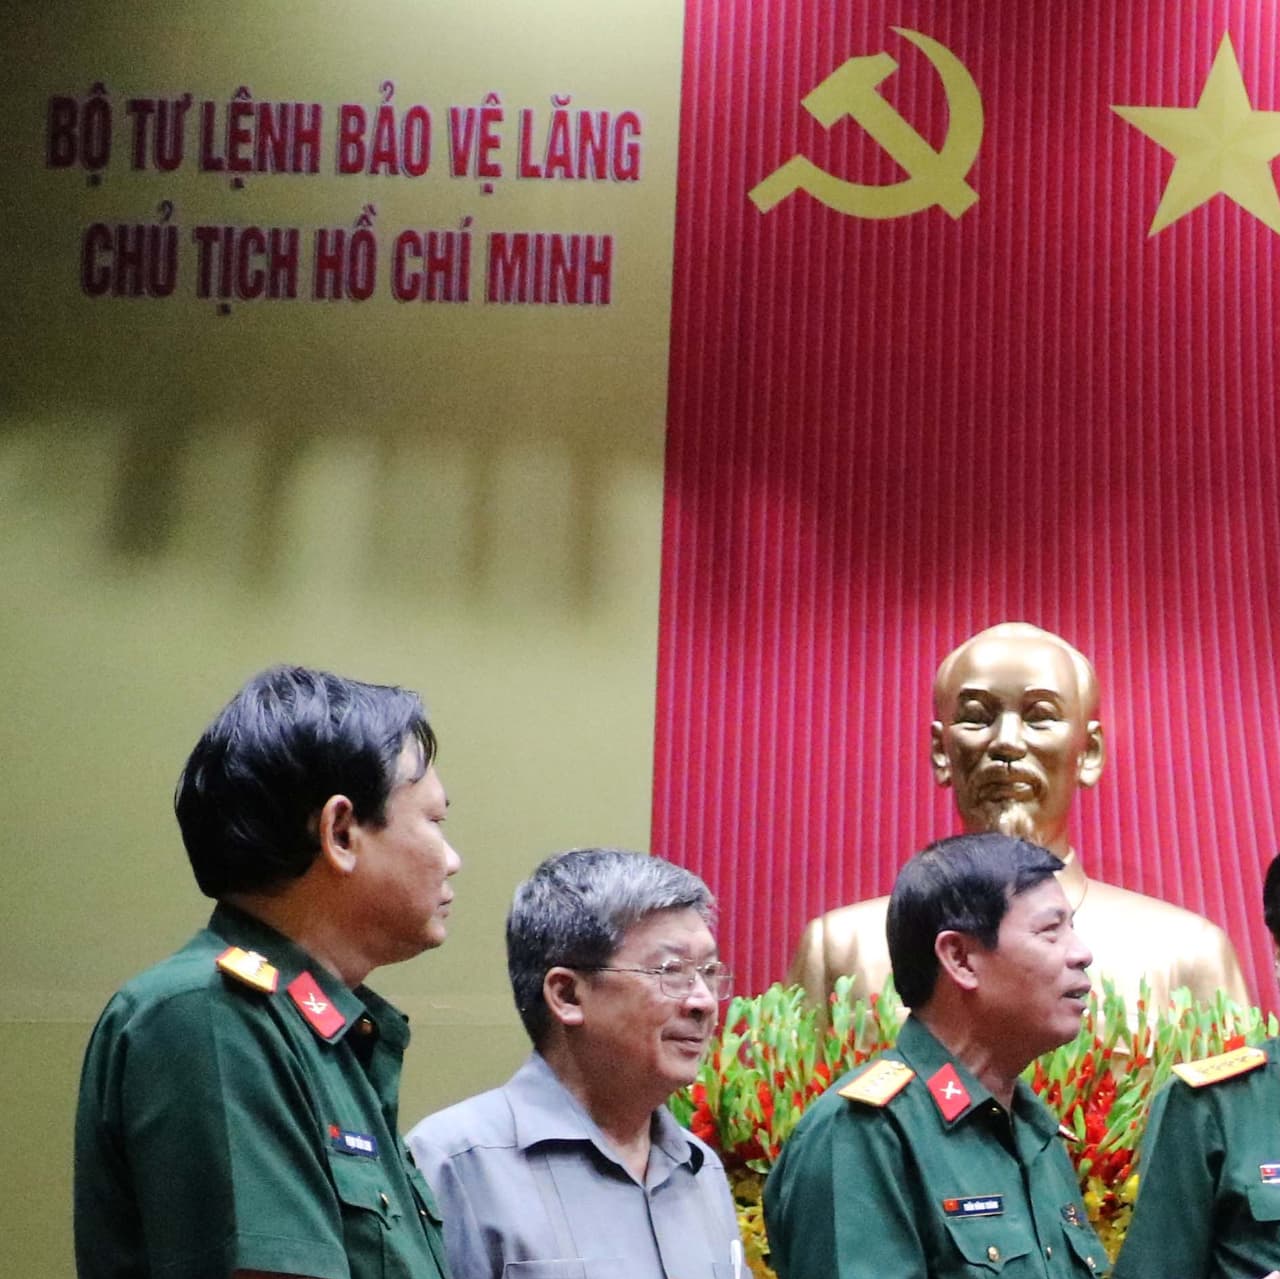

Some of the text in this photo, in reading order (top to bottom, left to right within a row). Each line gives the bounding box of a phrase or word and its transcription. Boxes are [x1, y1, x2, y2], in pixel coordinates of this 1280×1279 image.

[45, 80, 643, 194] BỘ TƯ LỆNH BẢO VỆ LĂNG
[81, 200, 615, 315] CHỦ TỊCH HỒ CHÍ MINH
